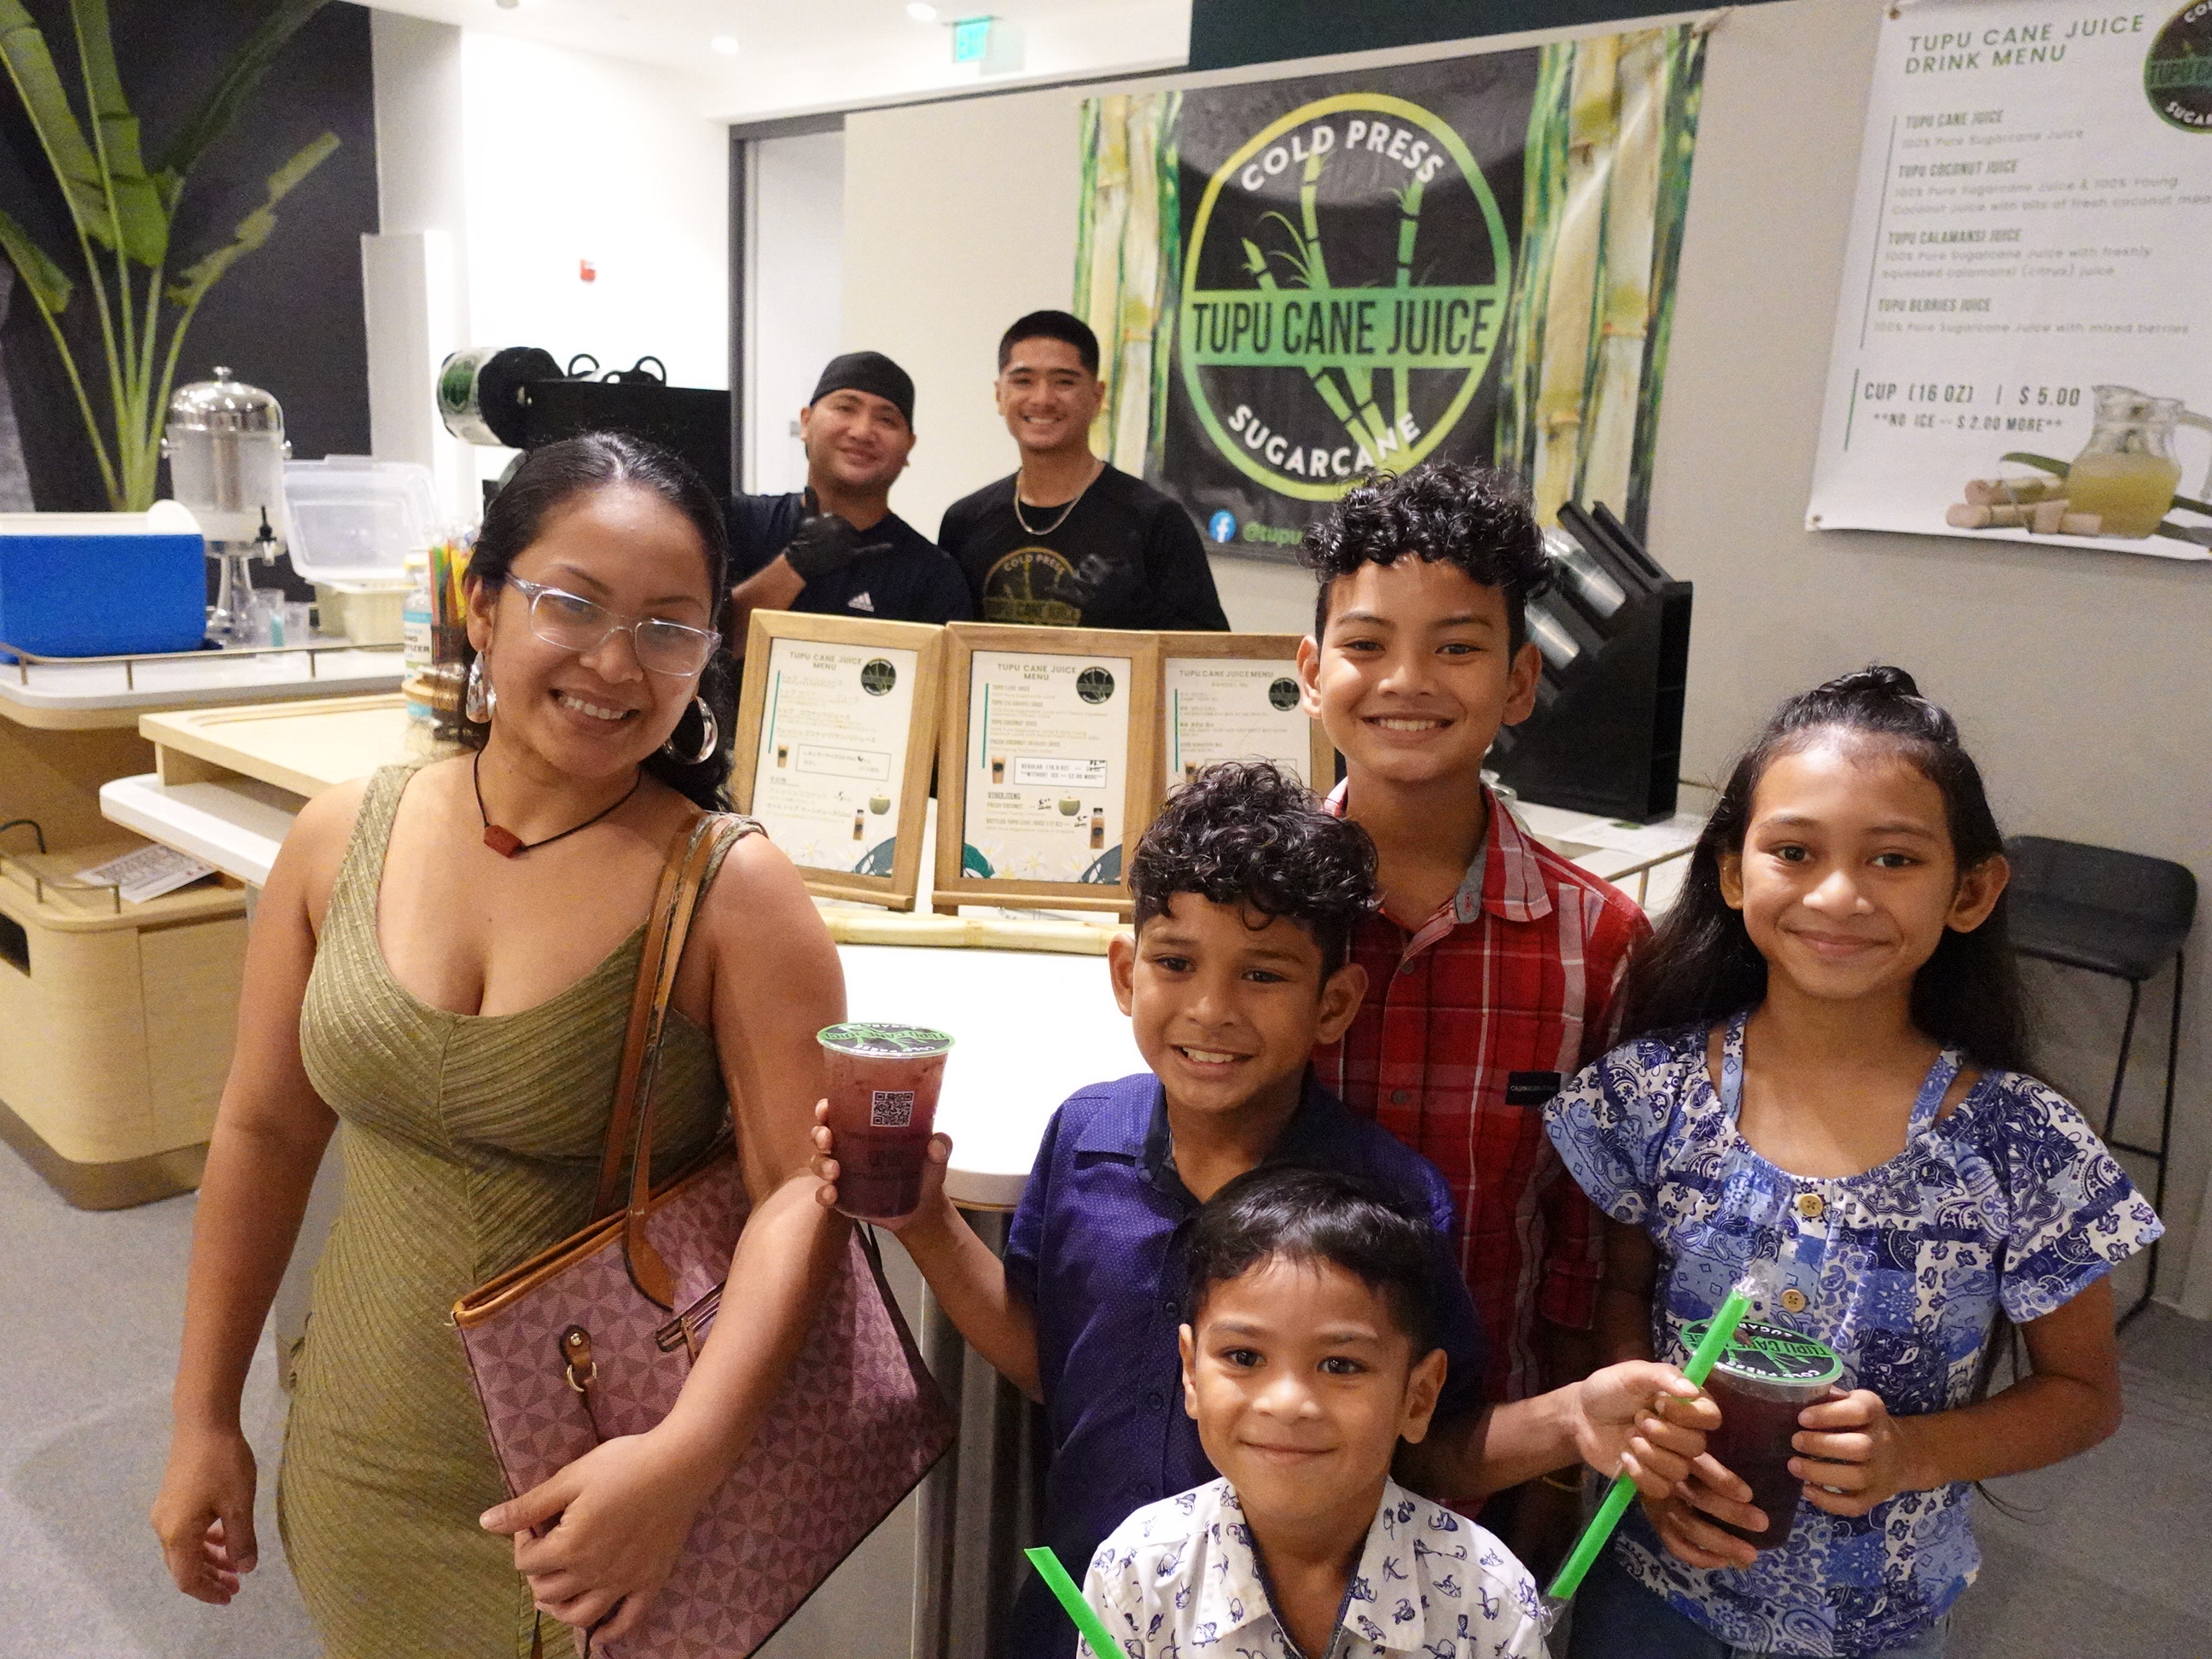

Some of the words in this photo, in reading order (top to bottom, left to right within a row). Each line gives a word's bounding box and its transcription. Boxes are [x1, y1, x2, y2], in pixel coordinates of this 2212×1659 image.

[1909, 31, 1972, 53] TUPU
[1982, 22, 2053, 46] CANE
[2064, 14, 2144, 39] JUICE
[1904, 50, 1980, 74] DRINK
[1992, 44, 2066, 67] MENU
[1906, 114, 1935, 130] TUPU
[1970, 109, 2004, 125] JUICE
[1241, 125, 1335, 191] COLD
[1346, 120, 1444, 183] PRESS
[1898, 164, 1927, 178] TUPU
[1929, 160, 1982, 177] COCONUT
[1985, 158, 2019, 174] JUICE
[1889, 230, 1917, 245] TUPU
[1989, 227, 2023, 242] JUICE
[1877, 297, 1906, 312] TUPU
[1908, 297, 1957, 312] BERRIES
[1959, 297, 1992, 312] JUICE
[1191, 301, 1273, 354] TUPU
[1283, 300, 1377, 355] CANE
[1387, 299, 1495, 356] JUICE
[1864, 381, 1898, 401] CUP
[1913, 413, 1936, 428] ICE
[1227, 404, 1422, 478] SUGARCANE
[789, 651, 812, 661] TUPU
[813, 654, 836, 664] CANE
[837, 656, 863, 666] JUICE
[812, 663, 837, 672] MENU
[997, 663, 1021, 672] TUPU
[1022, 665, 1048, 673] CANE
[1050, 666, 1078, 674] JUICE
[1023, 672, 1050, 681] MENU
[908, 1030, 947, 1040] TUPU
[1784, 1342, 1830, 1357] TUPU
